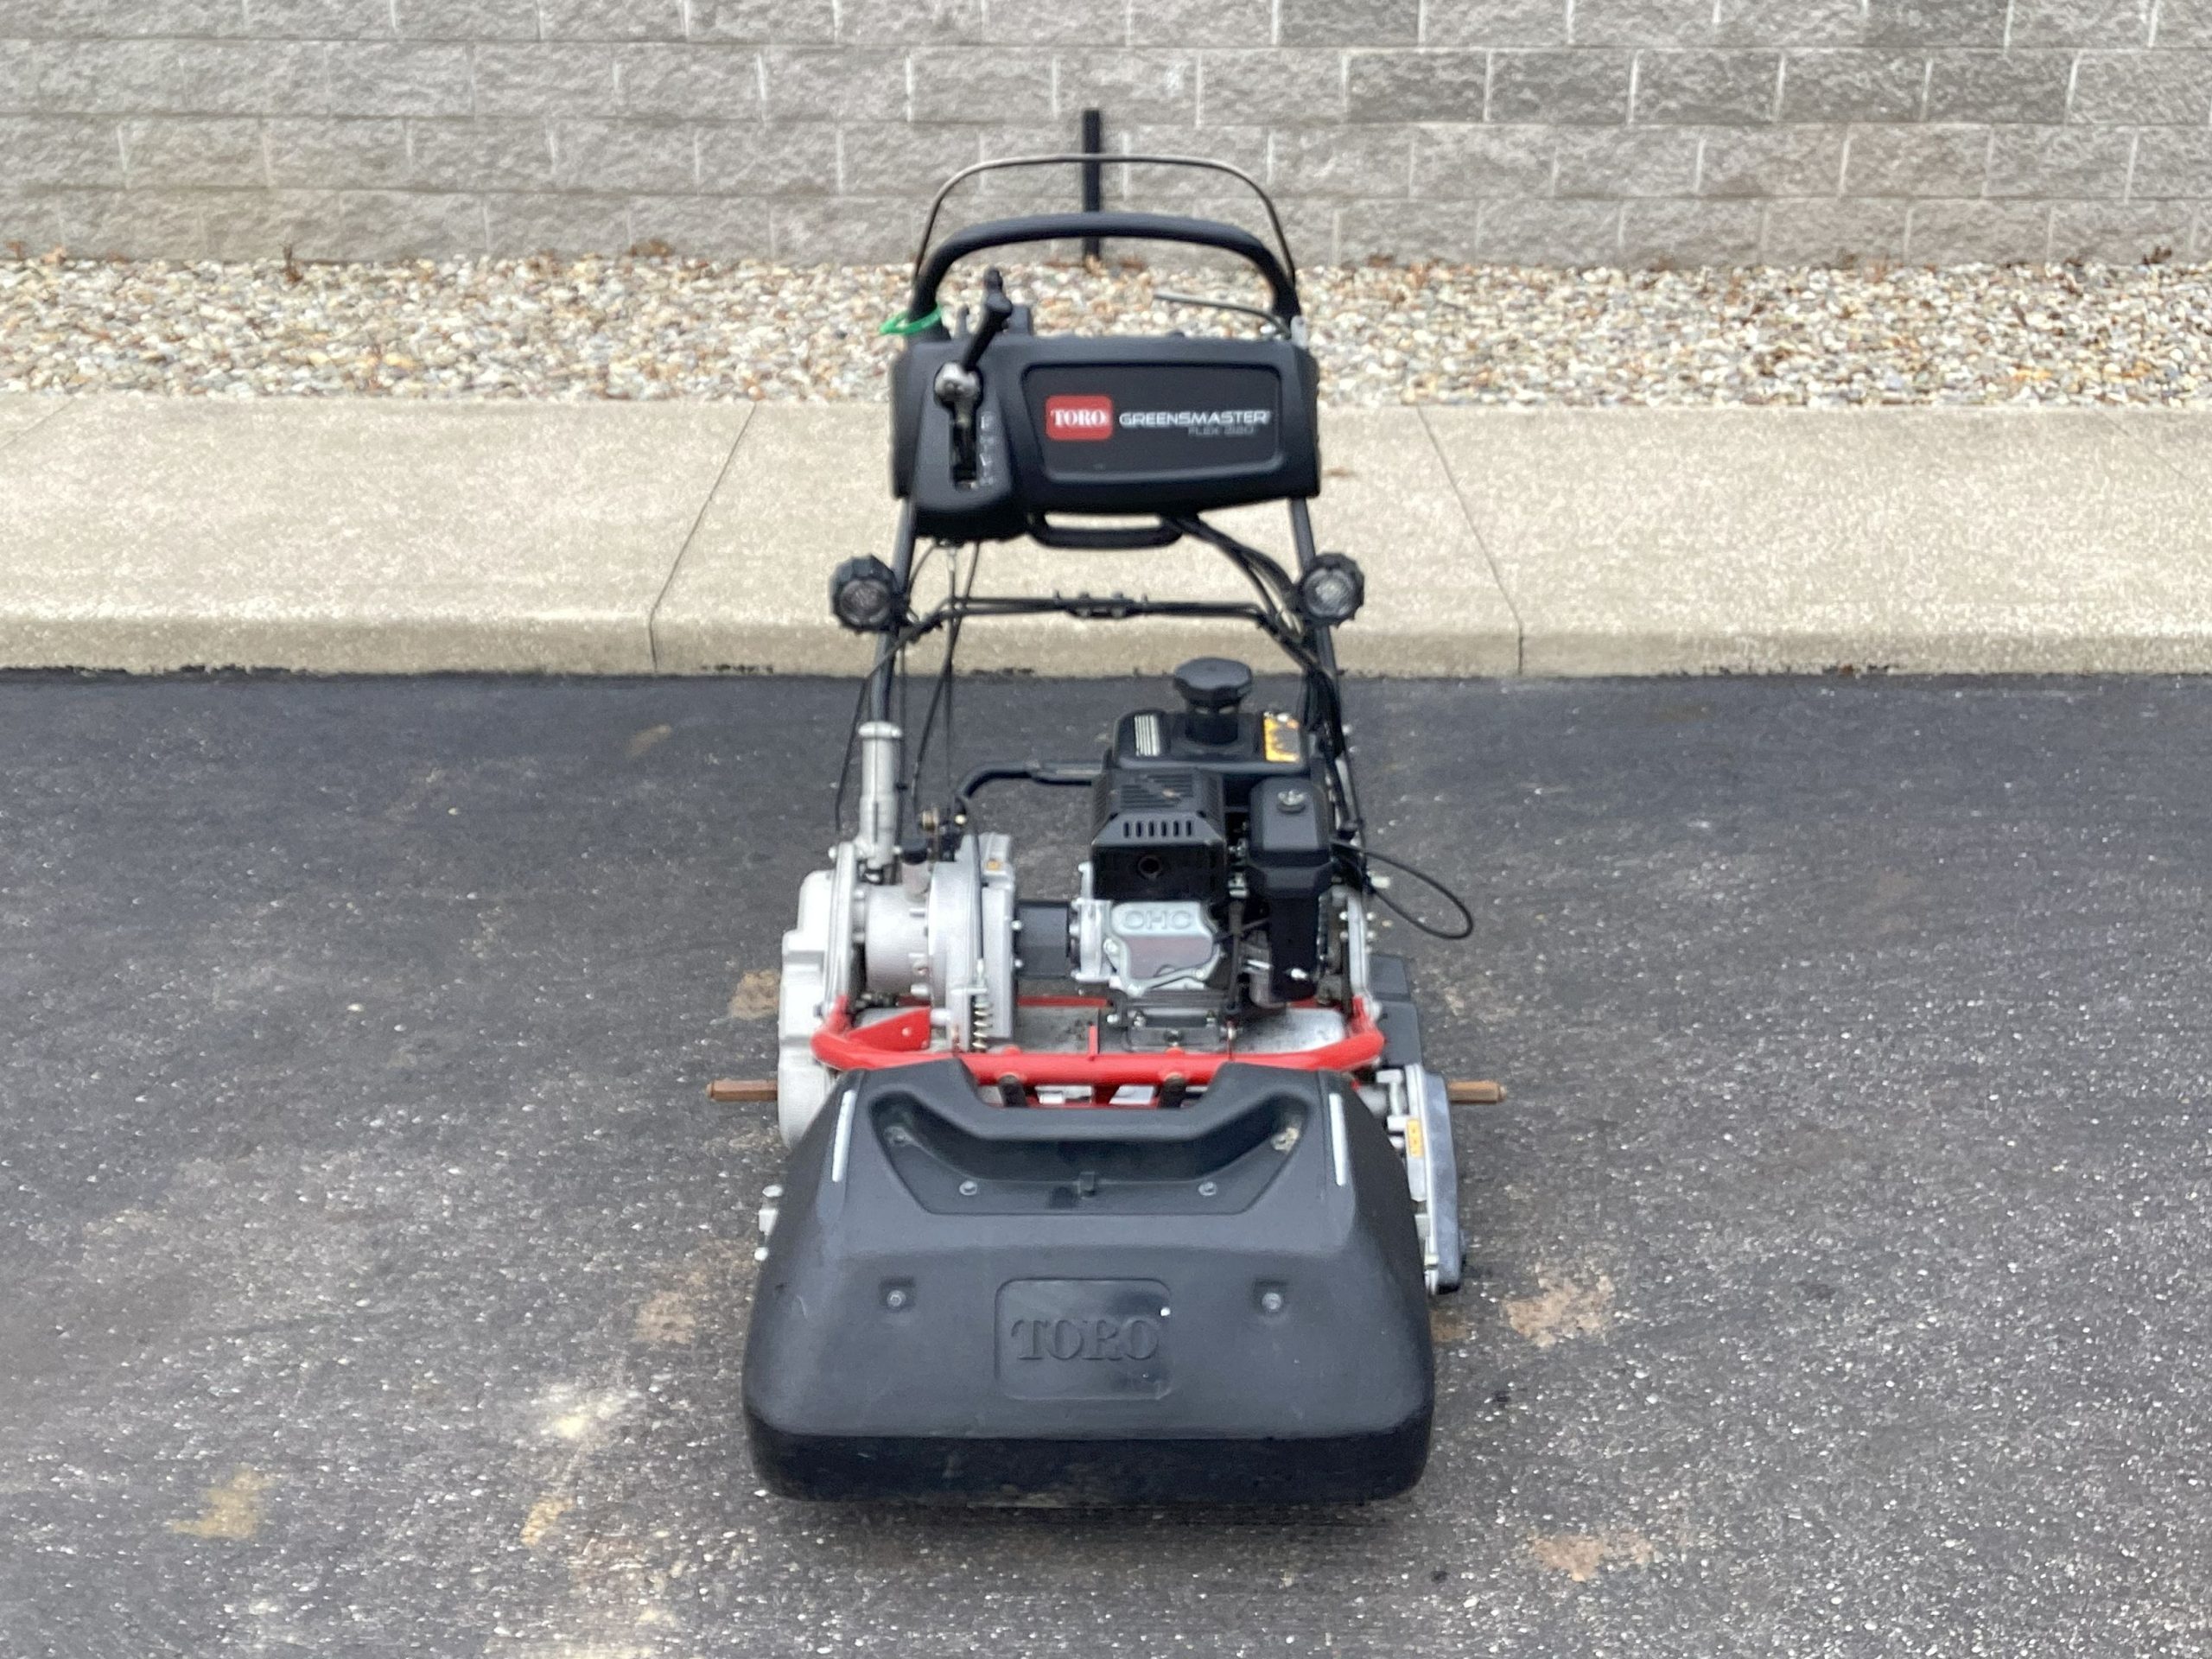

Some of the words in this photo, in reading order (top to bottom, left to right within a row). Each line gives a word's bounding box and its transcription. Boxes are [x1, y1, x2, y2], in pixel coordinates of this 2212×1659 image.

[1051, 409, 1107, 426] TORO
[1119, 410, 1269, 427] GREENSMASTER
[1123, 910, 1192, 930] OHC
[1011, 1319, 1159, 1361] TORO
